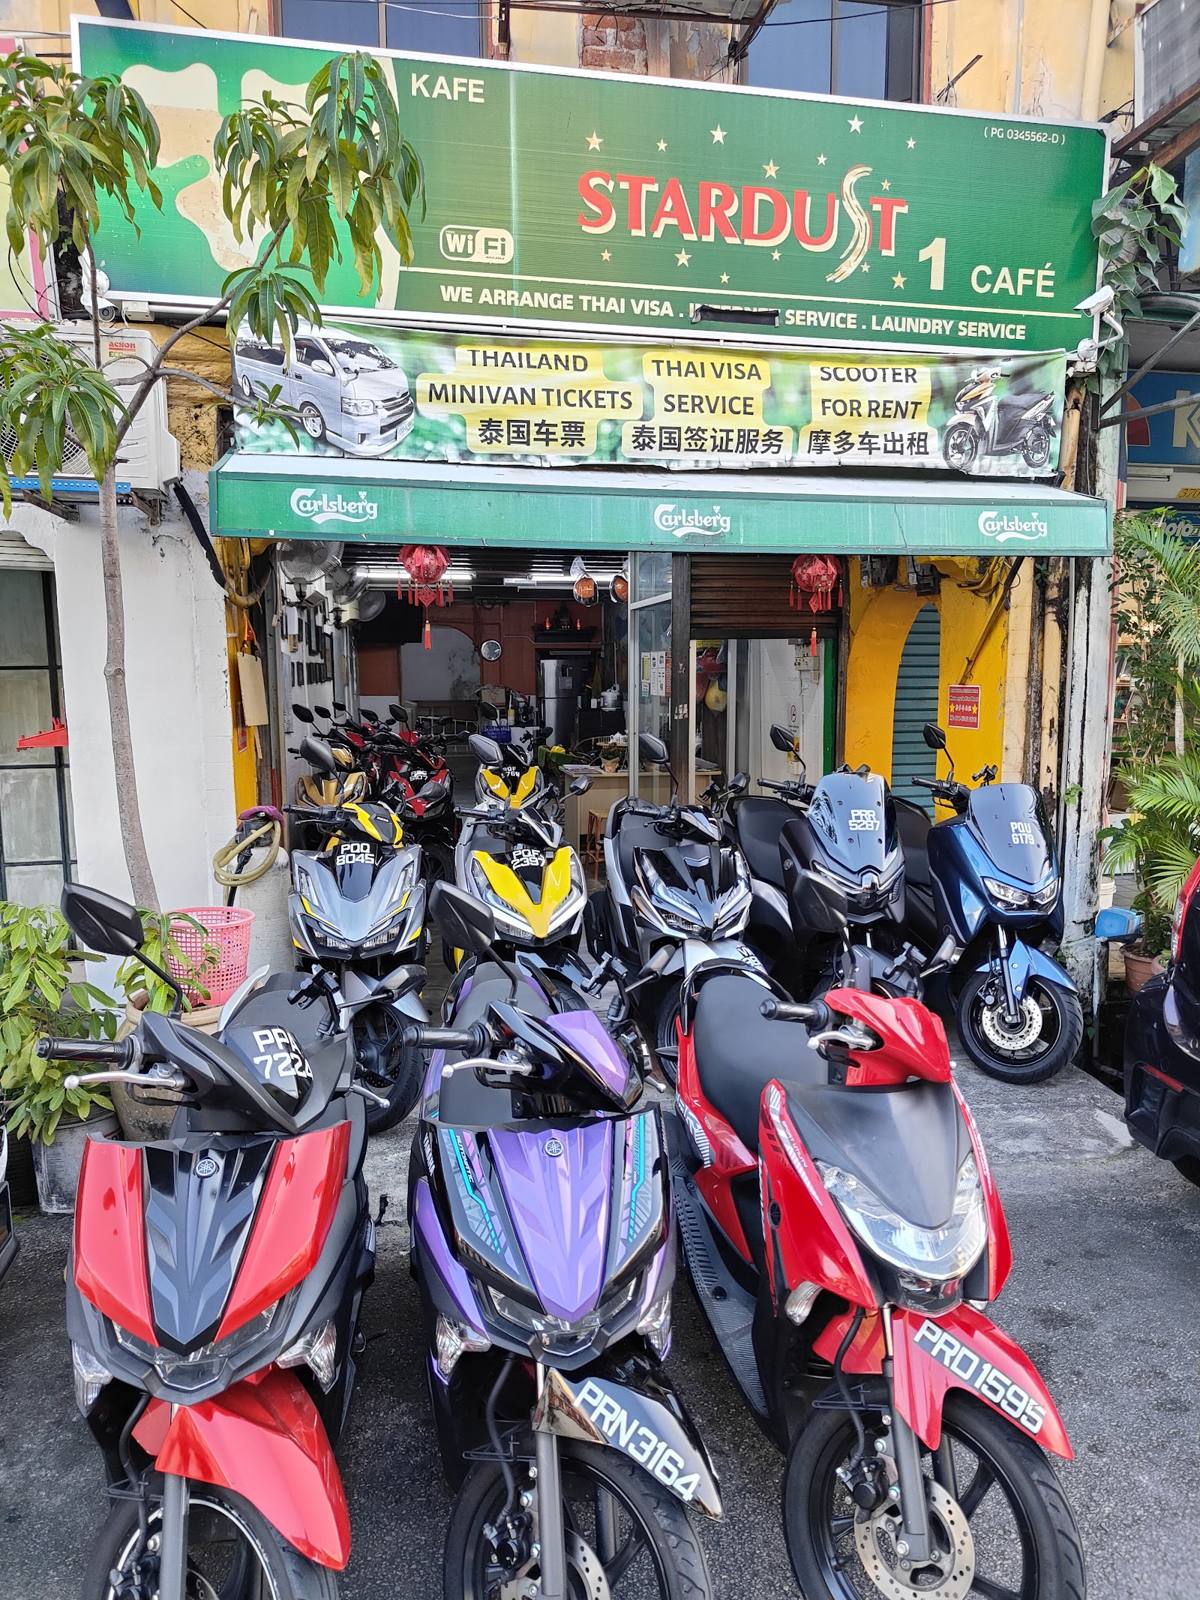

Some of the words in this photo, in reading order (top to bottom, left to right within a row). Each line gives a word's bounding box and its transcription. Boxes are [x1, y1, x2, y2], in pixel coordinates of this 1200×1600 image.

[411, 73, 485, 103] KAFE
[577, 164, 909, 283] STARDUST
[918, 237, 947, 291] 1
[970, 262, 1056, 298] CAFÉ
[440, 285, 473, 304] WE
[478, 288, 574, 311] ARRANGE
[579, 295, 626, 314] THAI
[630, 299, 674, 317] VISA
[785, 309, 857, 329] SERVICE
[871, 314, 953, 336] LAUNDRY
[958, 321, 1026, 340] SERVICE
[467, 349, 588, 373] THAILAND
[651, 359, 706, 379] THAI
[710, 361, 762, 381] VISA
[820, 366, 917, 384] SCOOTER
[428, 383, 537, 406] MINIVAN
[541, 388, 633, 410] TICKETS
[663, 393, 754, 416] SERVICE
[821, 398, 863, 418] FOR
[867, 399, 922, 420] RENT
[478, 418, 586, 448] 泰国车票
[631, 425, 784, 456] 泰国签证服务
[807, 430, 930, 456] 摩多车出租
[290, 488, 378, 522] Carlsberg
[653, 503, 731, 537] Carlsberg
[977, 511, 1048, 539] Carlsberg
[336, 853, 375, 866] 8045
[913, 1318, 1047, 1435] PRD1595
[573, 1380, 702, 1501] PRN3164
